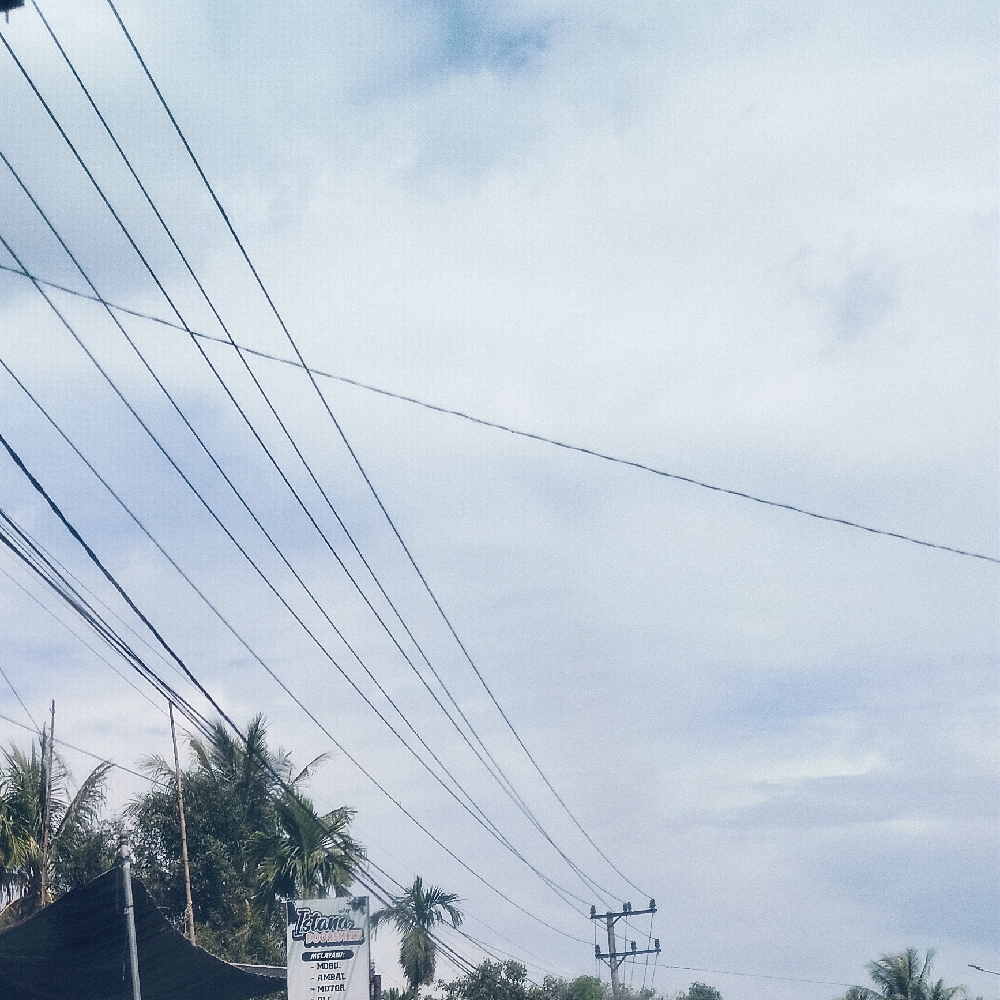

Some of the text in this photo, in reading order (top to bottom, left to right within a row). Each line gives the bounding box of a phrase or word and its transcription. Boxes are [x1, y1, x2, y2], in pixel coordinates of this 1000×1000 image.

[293, 908, 355, 938] Istana
[316, 962, 342, 970] MOBIL
[317, 973, 347, 981] AMBAL
[317, 984, 346, 992] MOTOR
